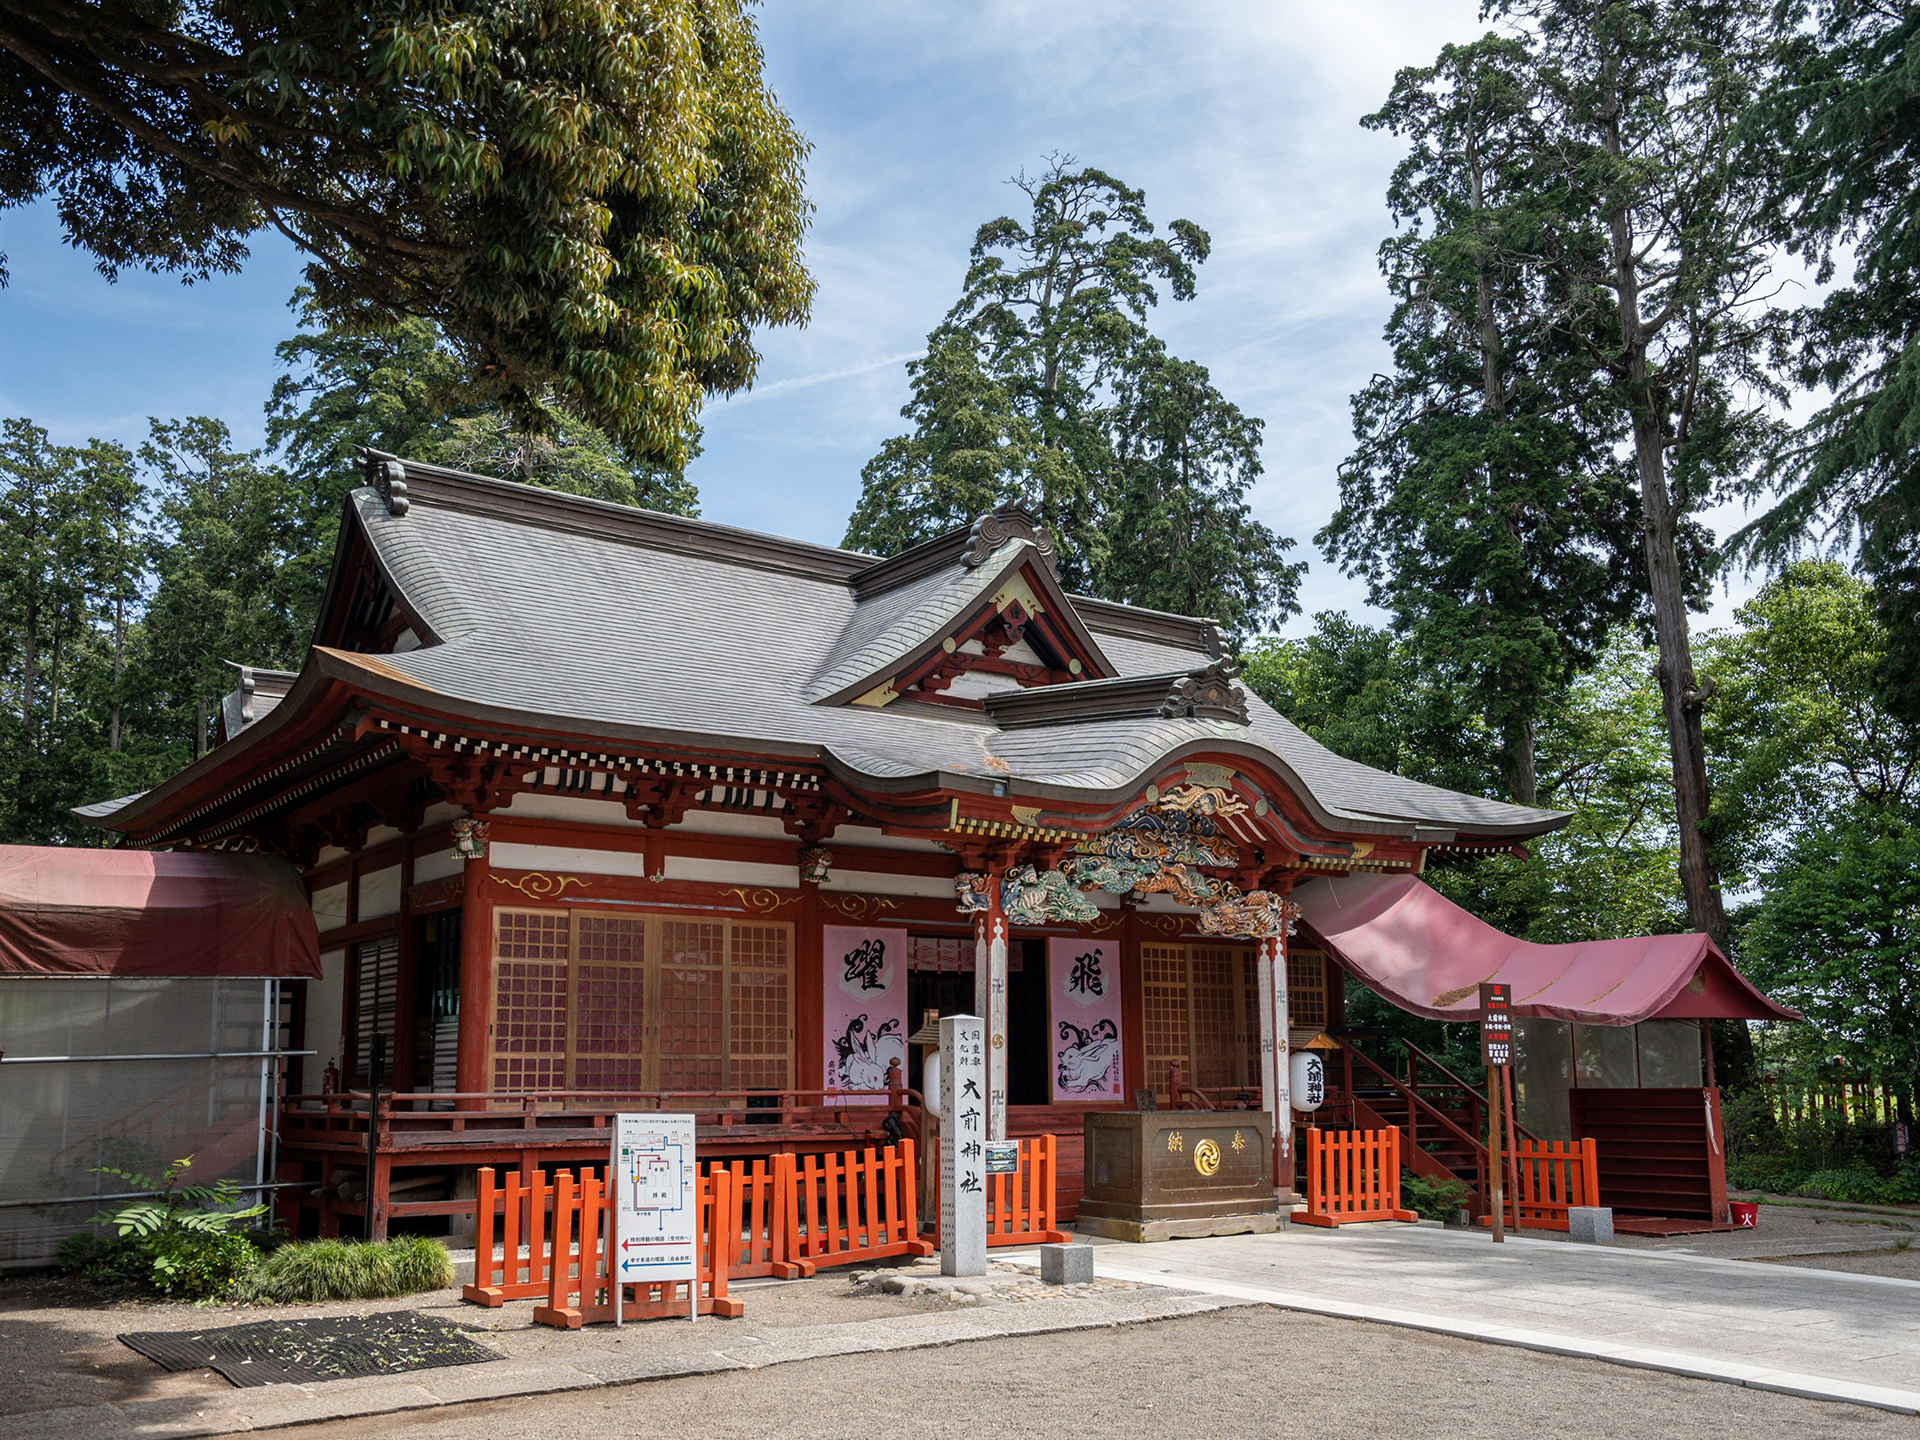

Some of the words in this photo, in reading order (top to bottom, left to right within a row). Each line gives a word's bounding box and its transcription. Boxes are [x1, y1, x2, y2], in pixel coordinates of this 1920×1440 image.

[844, 939, 886, 991] 躍
[1068, 948, 1104, 996] 飛
[1487, 1014, 1508, 1022] 大前神社
[1306, 1058, 1322, 1104] 大前神社
[959, 1078, 983, 1193] 大前神社
[1741, 1212, 1753, 1225] 火
